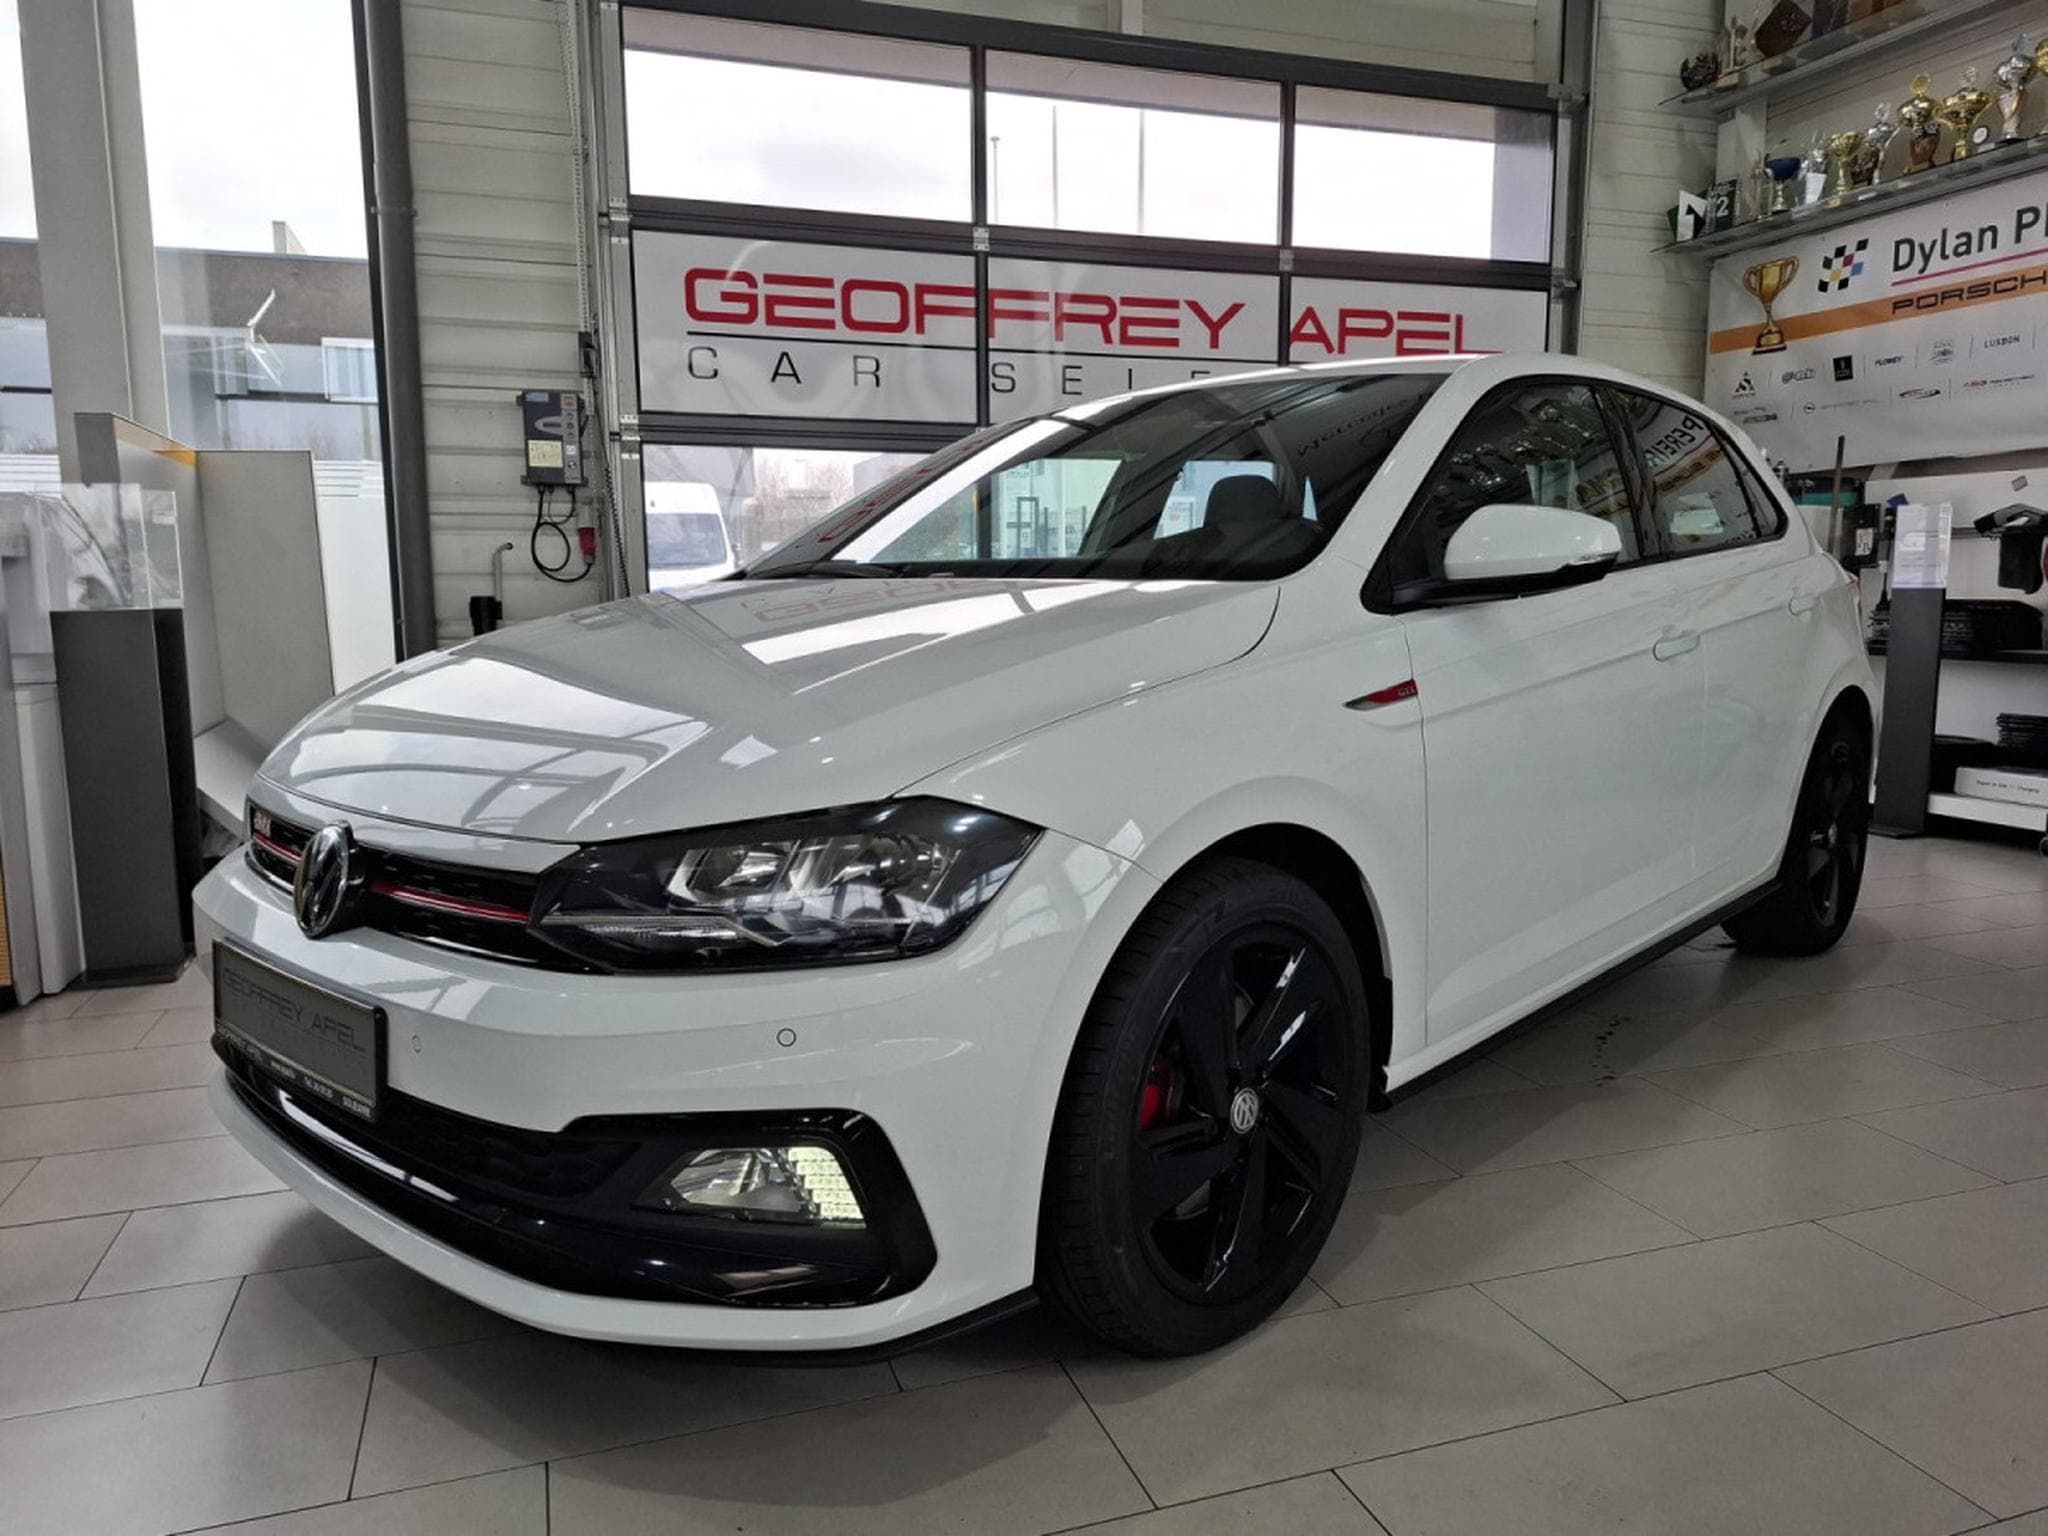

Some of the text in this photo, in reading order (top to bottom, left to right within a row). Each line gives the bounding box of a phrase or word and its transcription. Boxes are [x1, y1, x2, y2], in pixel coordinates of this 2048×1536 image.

[1891, 200, 2048, 275] Dylan P
[684, 268, 1500, 358] GEOFFREY APEL
[687, 345, 1211, 394] CAR SEL
